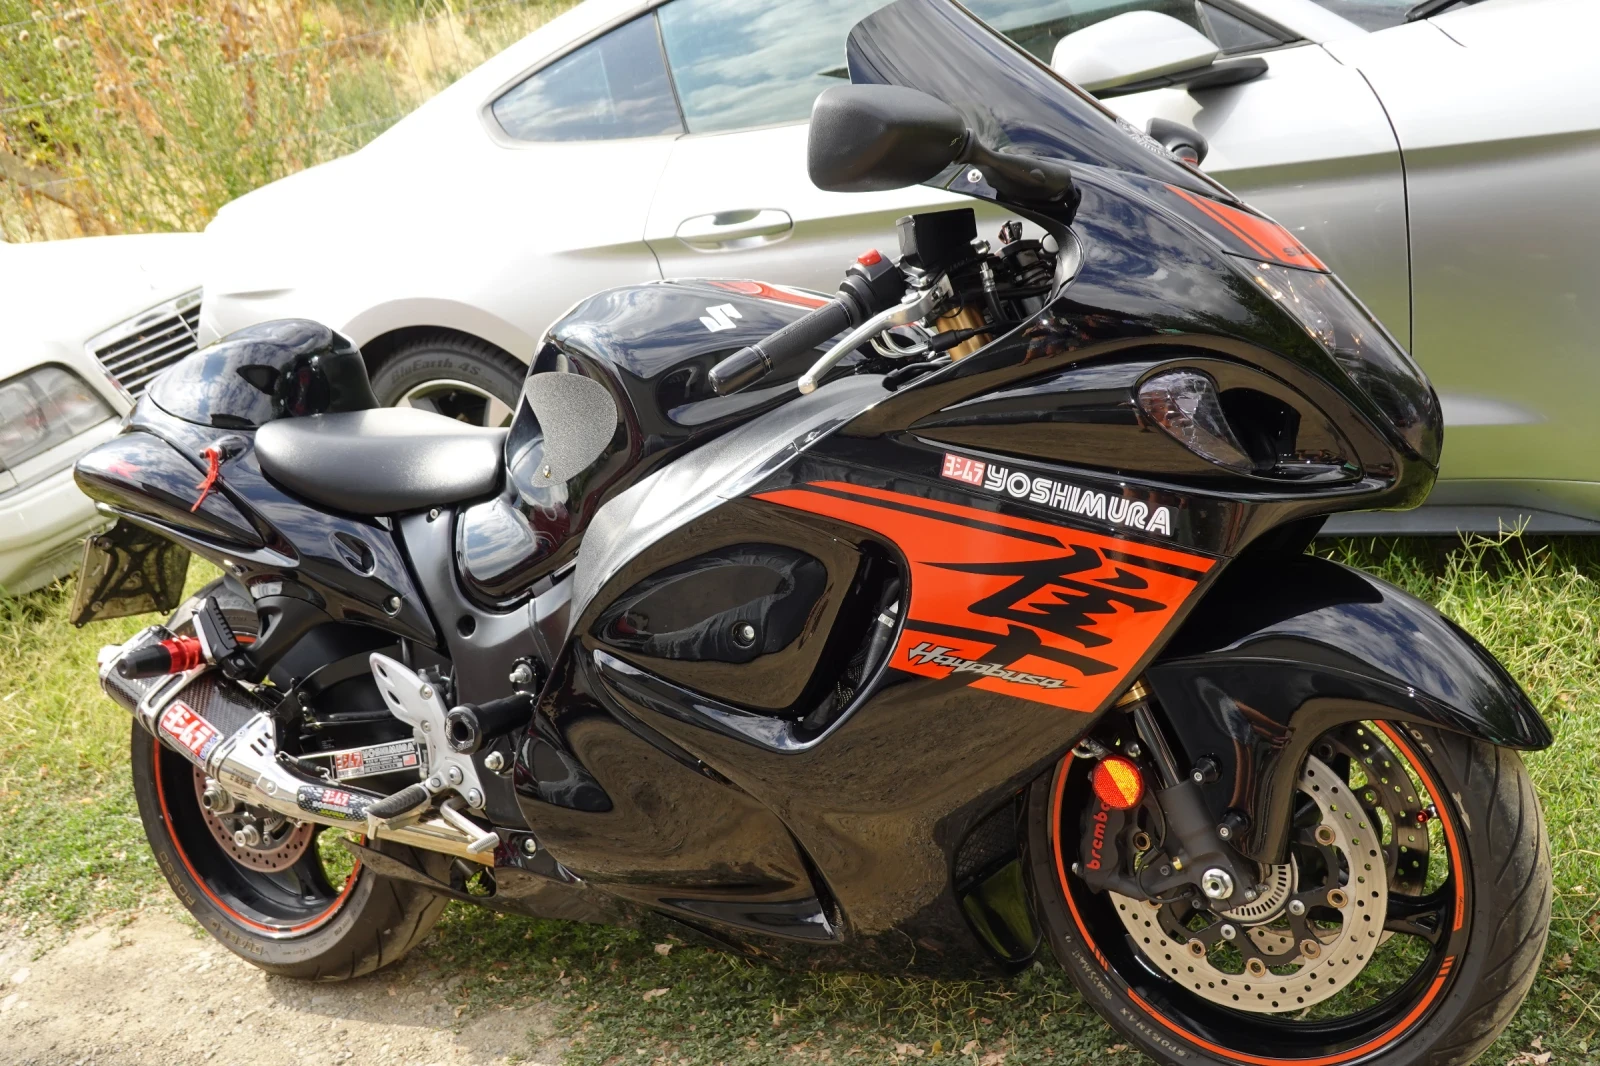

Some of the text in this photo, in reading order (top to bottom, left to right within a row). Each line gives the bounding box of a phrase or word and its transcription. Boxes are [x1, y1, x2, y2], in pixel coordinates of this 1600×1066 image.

[984, 464, 1172, 536] YOSHIMURA
[908, 641, 1078, 690] Hayabusa
[1086, 801, 1112, 870] brembo
[160, 851, 196, 906] ROSSO
